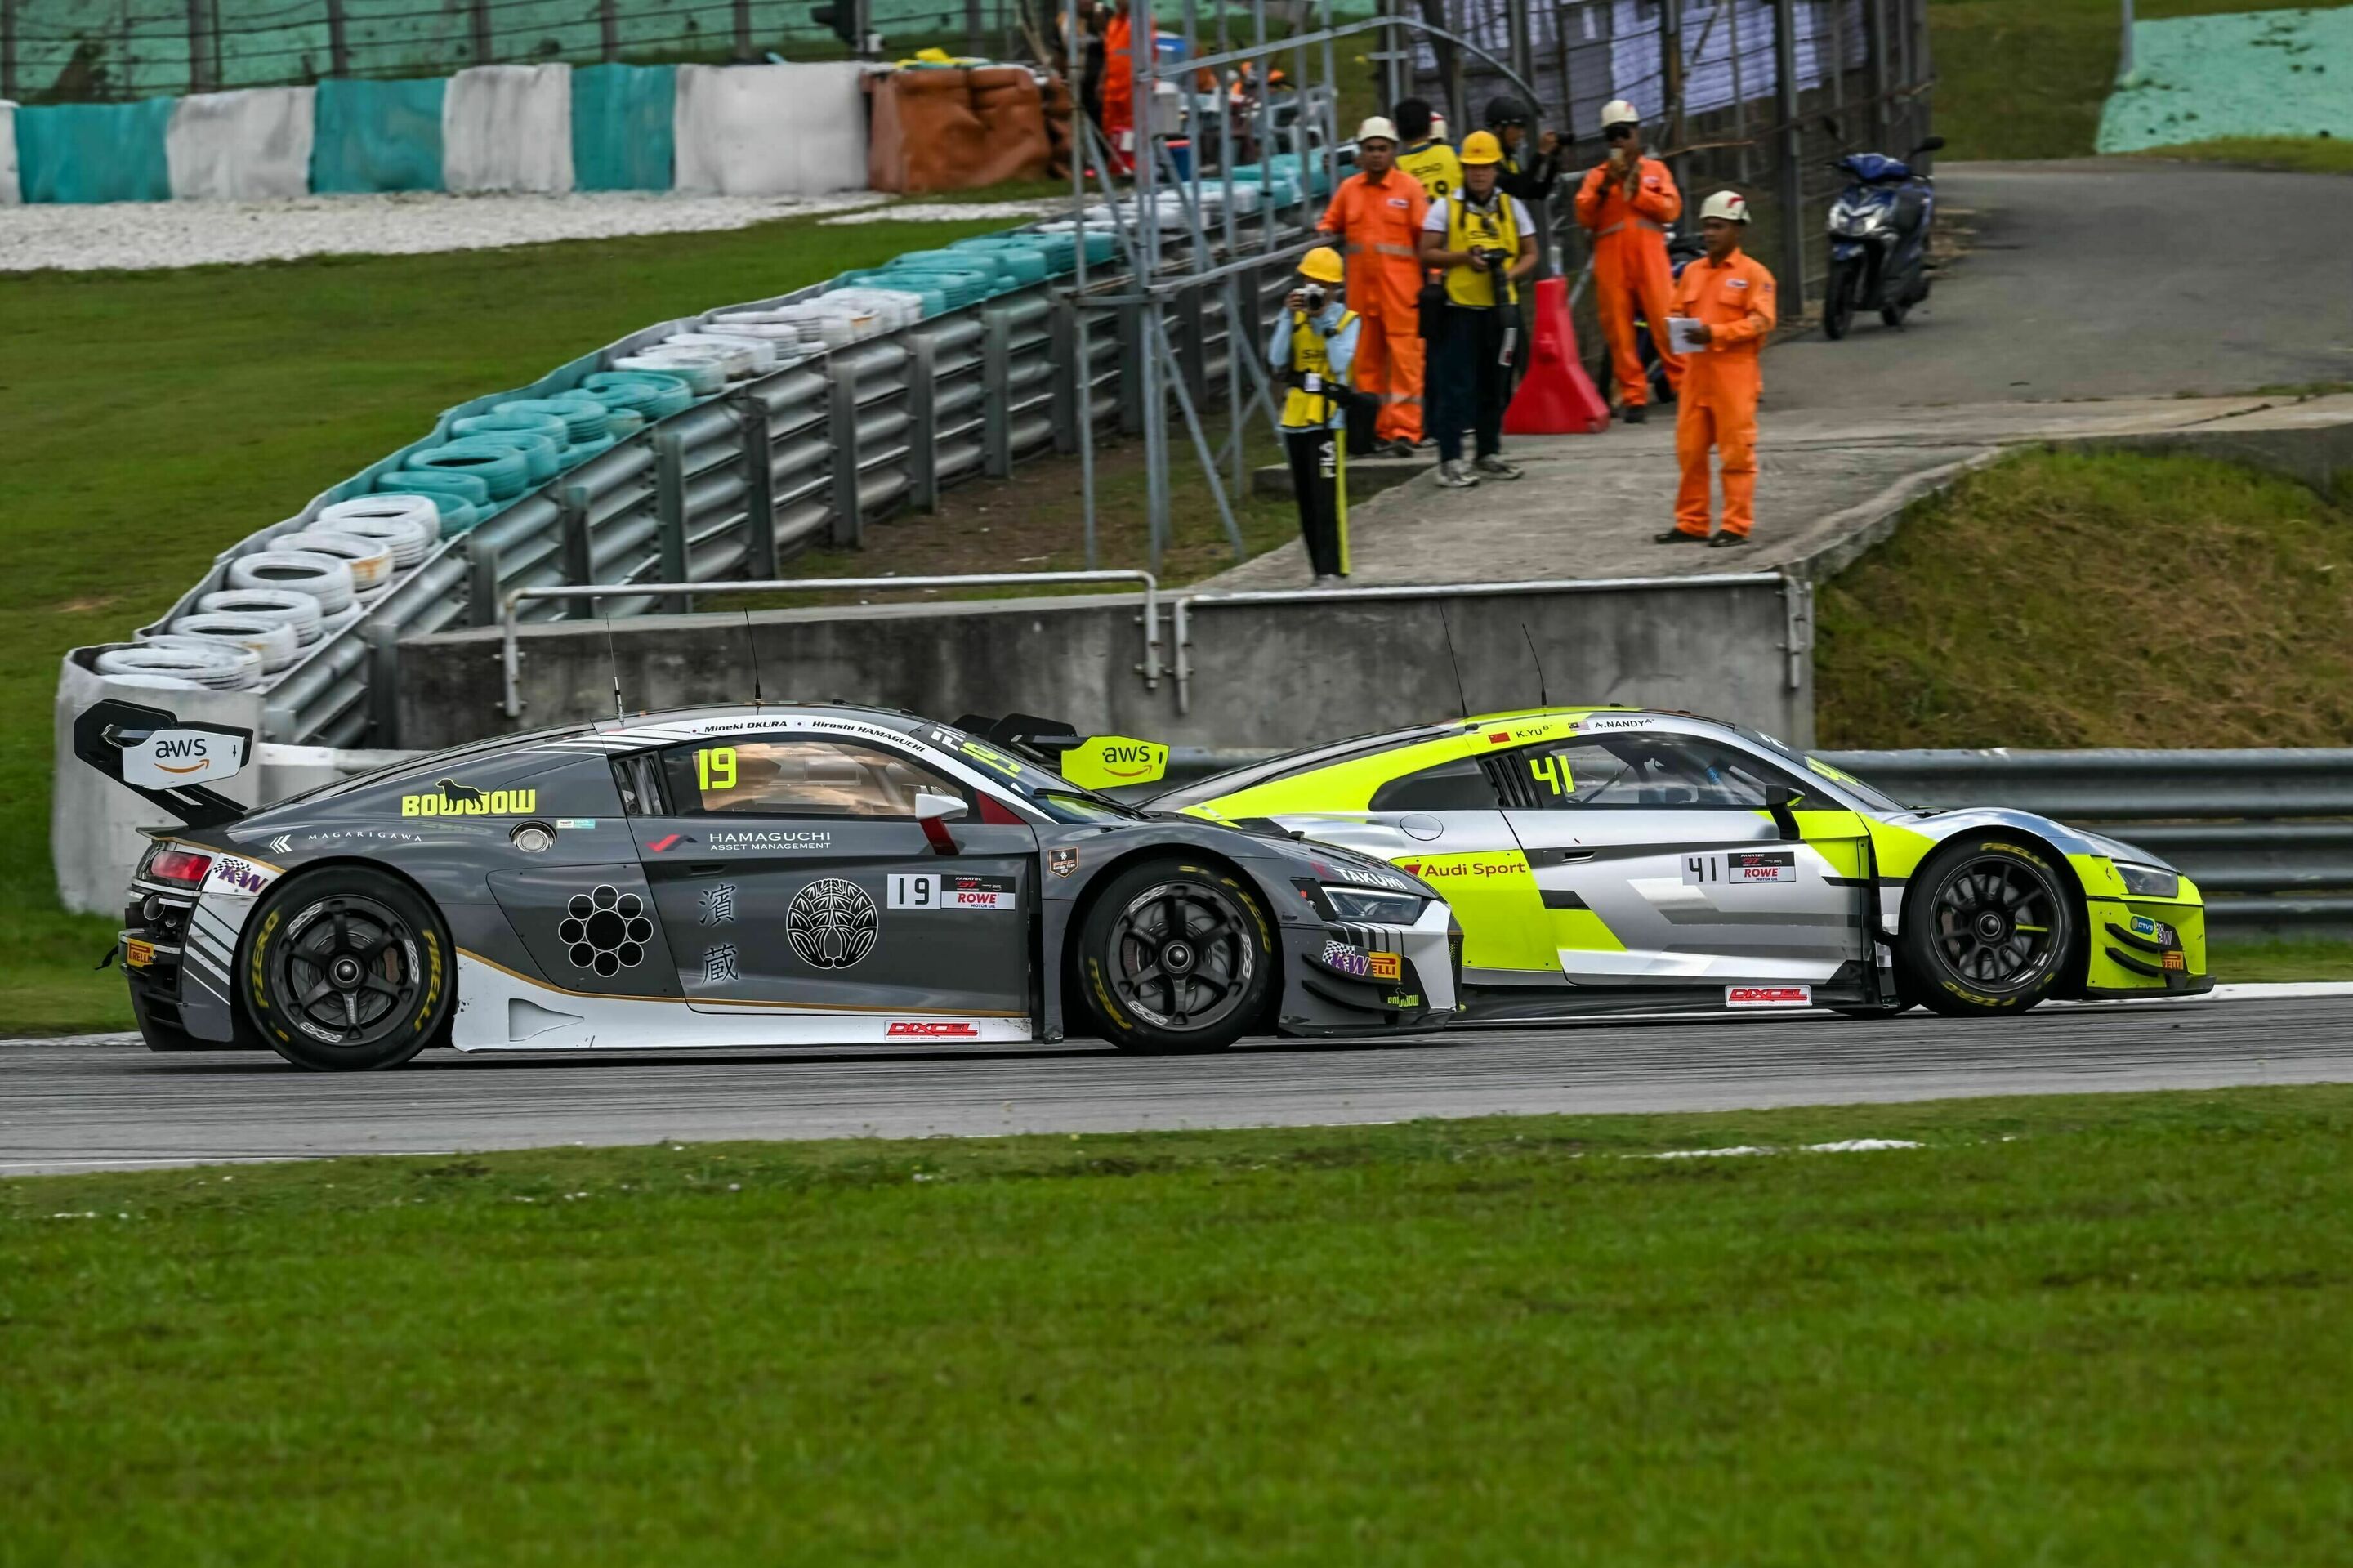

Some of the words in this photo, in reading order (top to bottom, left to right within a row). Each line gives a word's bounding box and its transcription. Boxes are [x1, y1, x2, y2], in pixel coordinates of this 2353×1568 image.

[1318, 440, 1337, 478] FILA
[704, 723, 743, 733] Mineki
[747, 721, 788, 729] OKURA
[812, 721, 856, 730] Hiroshi
[857, 726, 926, 753] HAMAGUCHI
[155, 738, 207, 759] aws
[1103, 745, 1150, 763] aws
[699, 747, 737, 790] 19
[1529, 754, 1576, 795] 41
[308, 831, 422, 842] MAGARIGAWA
[709, 832, 831, 842] HAMAGUCHI
[217, 865, 268, 894] KW
[1333, 867, 1408, 890] TAKUMI
[1424, 864, 1467, 877] Audi
[1473, 862, 1526, 878] Sport
[1688, 856, 1717, 882] 41
[1744, 868, 1779, 878] ROWE
[899, 877, 930, 905] 19
[958, 893, 997, 904] ROWE
[1330, 952, 1371, 976] KW
[1728, 989, 1808, 1002] DIXCEL
[886, 1022, 979, 1037] DIXCEL
